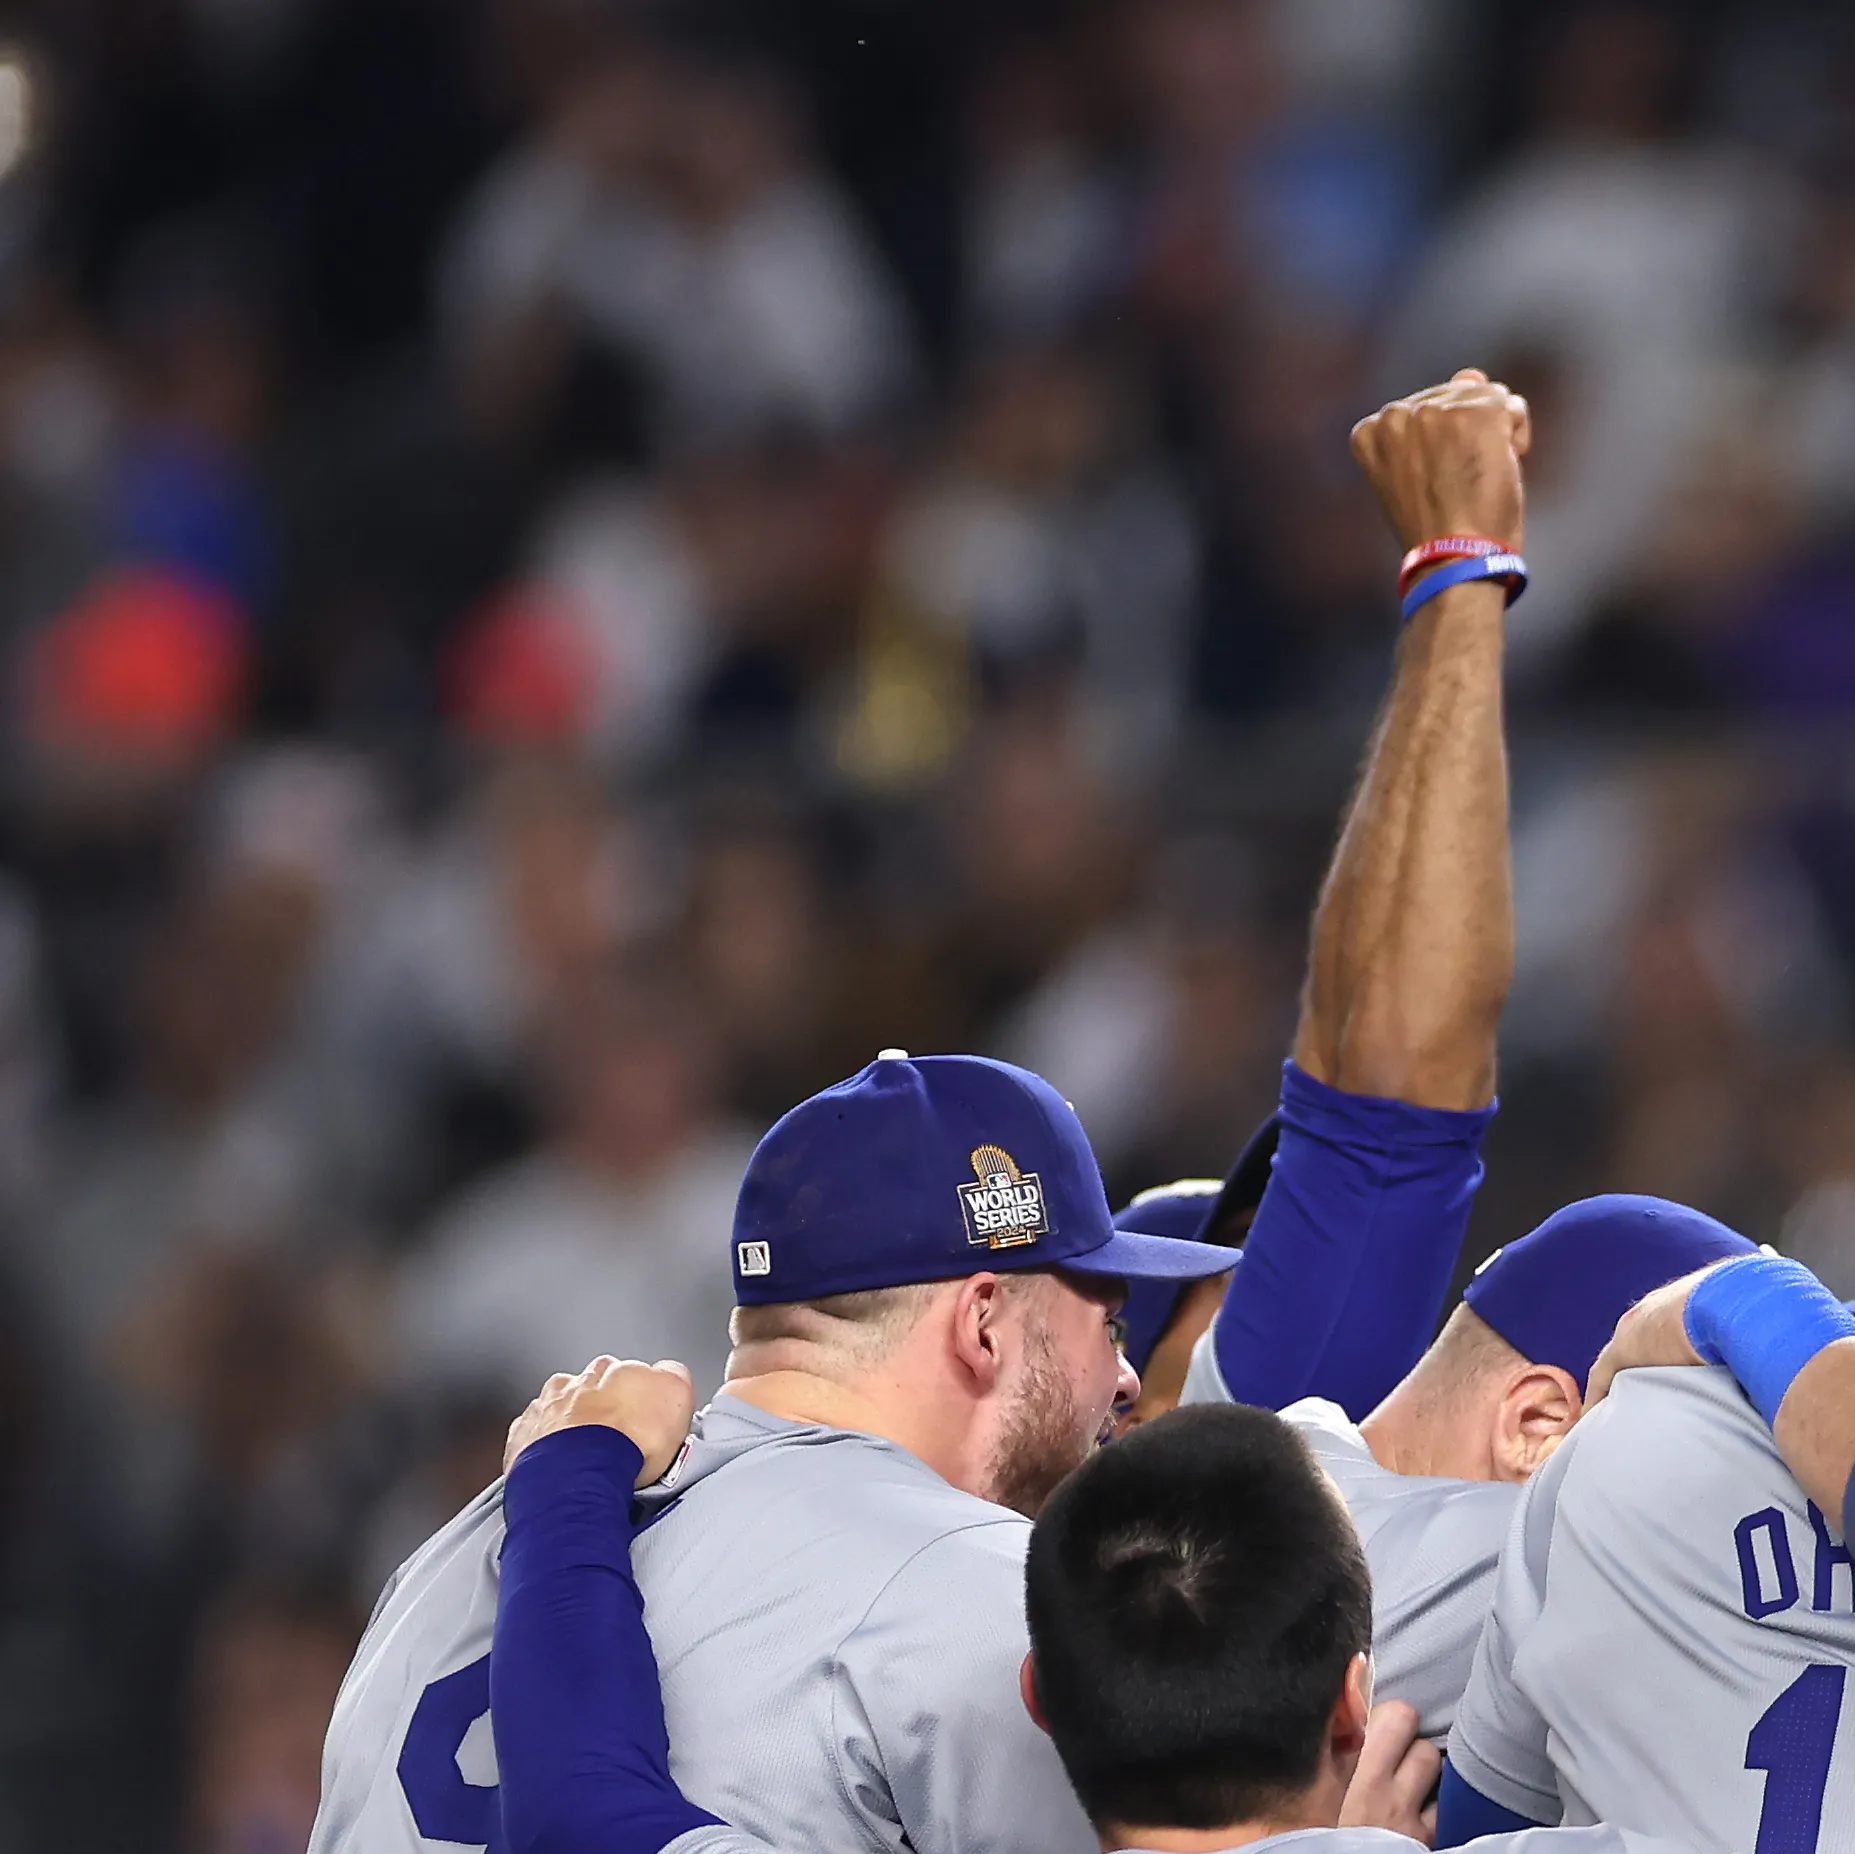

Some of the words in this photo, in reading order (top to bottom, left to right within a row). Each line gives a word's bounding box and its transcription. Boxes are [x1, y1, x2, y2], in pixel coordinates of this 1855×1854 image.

[965, 1185, 1039, 1213] WORLD
[974, 1203, 1041, 1231] SERIES
[996, 1225, 1026, 1238] 2024
